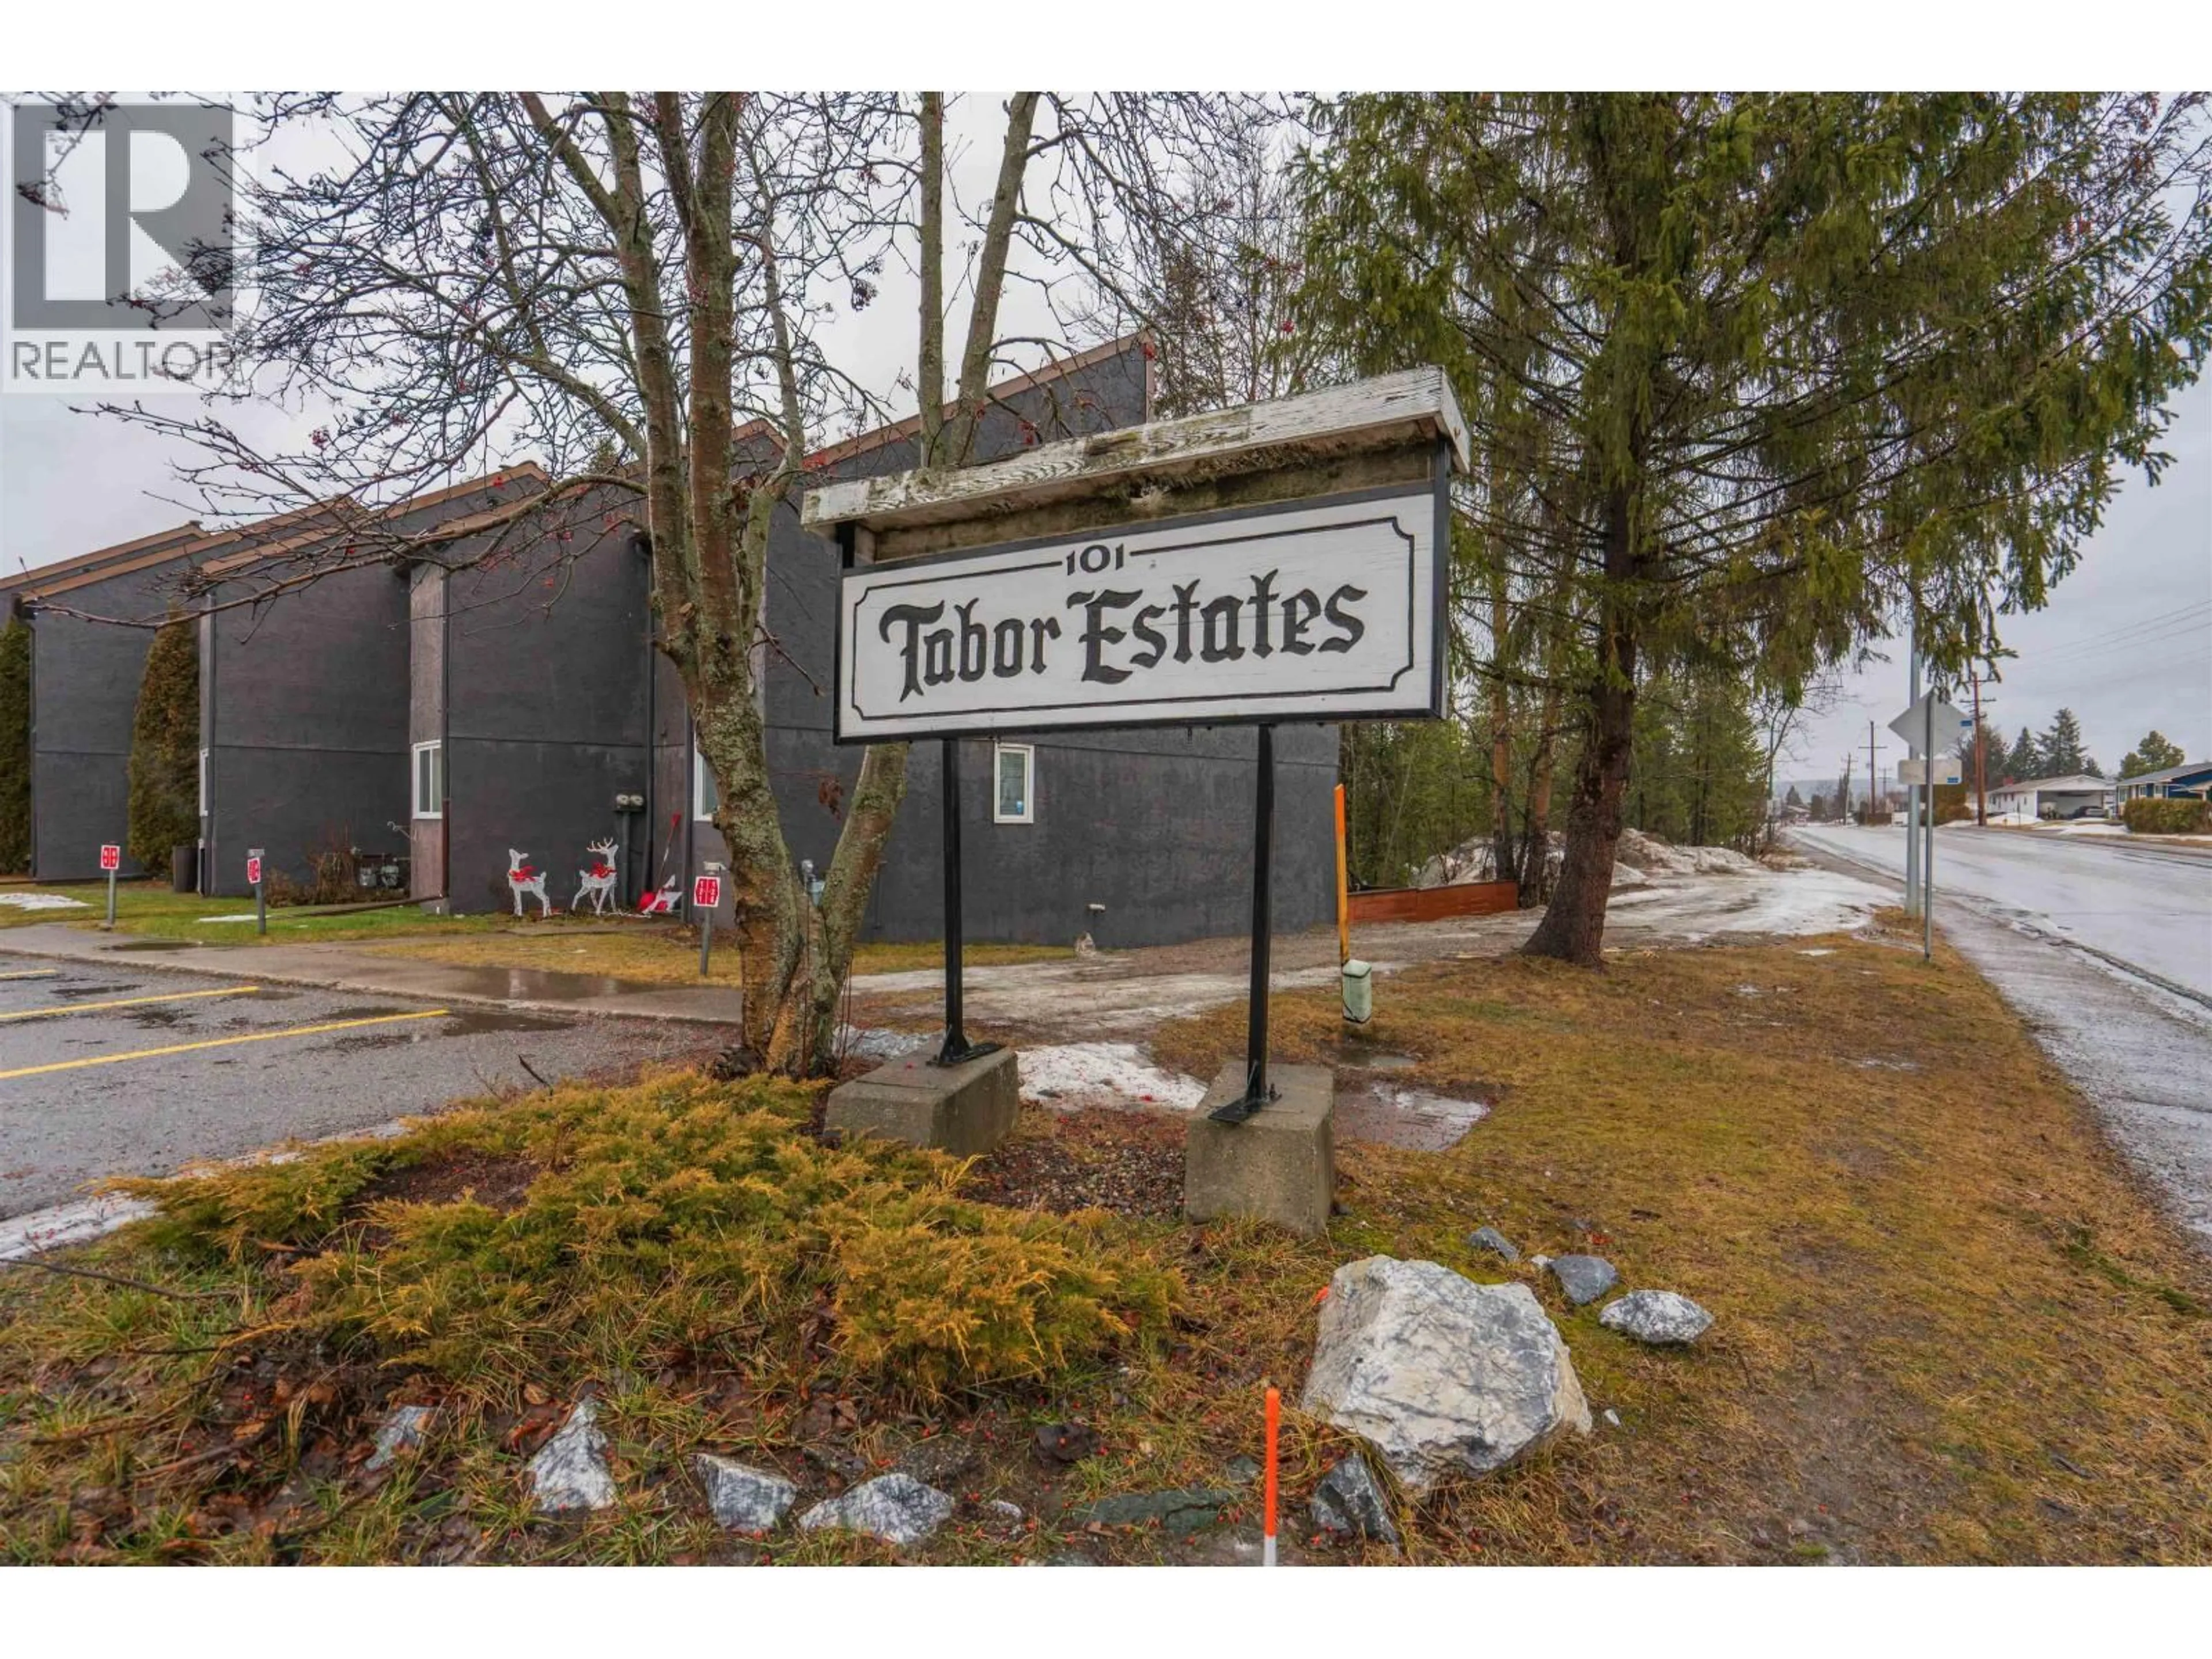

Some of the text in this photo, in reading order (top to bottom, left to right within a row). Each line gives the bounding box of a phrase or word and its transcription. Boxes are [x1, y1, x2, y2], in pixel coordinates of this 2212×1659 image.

[1066, 543, 1124, 575] 101
[879, 569, 1368, 703] Tabor Estates
